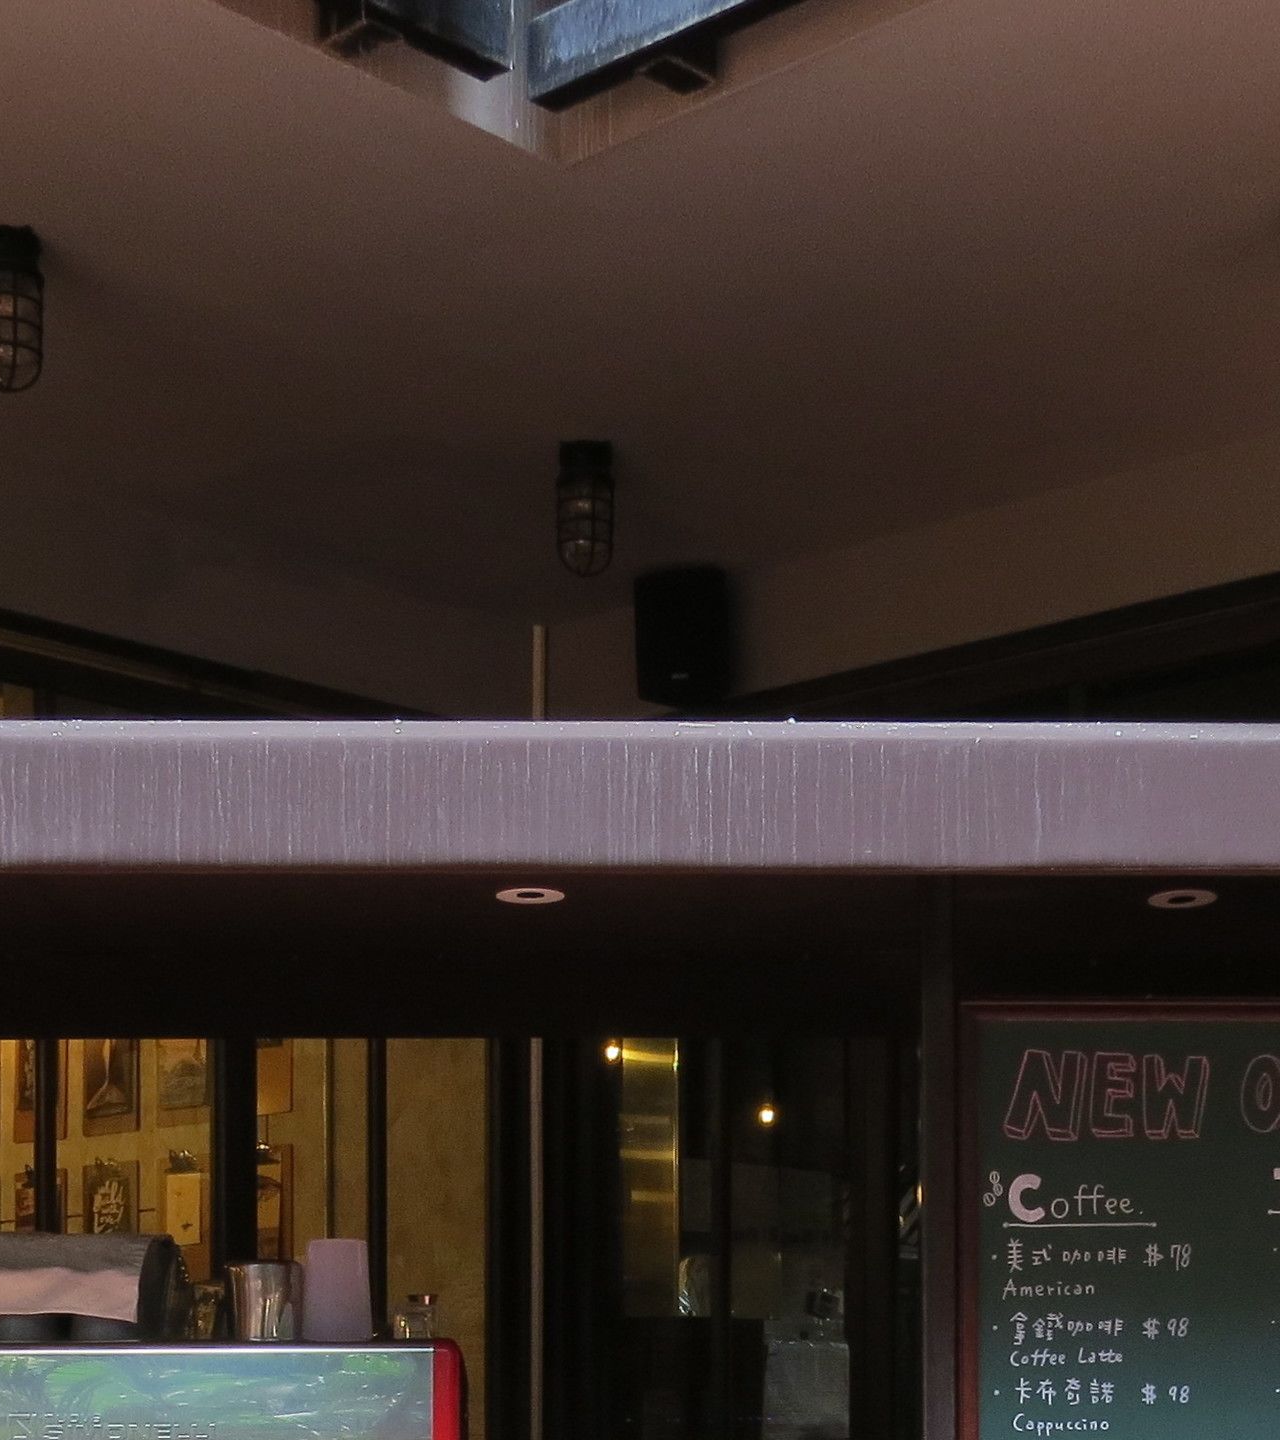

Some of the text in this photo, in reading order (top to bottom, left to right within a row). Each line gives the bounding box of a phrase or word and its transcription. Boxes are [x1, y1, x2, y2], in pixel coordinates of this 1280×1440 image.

[1004, 1049, 1210, 1142] NEW
[1008, 1238, 1191, 1273] 美式咖啡 $78
[1003, 1279, 1095, 1300] American
[1010, 1312, 1123, 1345] 拿鐵咖啡
[1010, 1348, 1123, 1367] Coffee Latte
[1015, 1378, 1114, 1405] 卡布奇諾
[1013, 1413, 1109, 1436] Cappuccino
